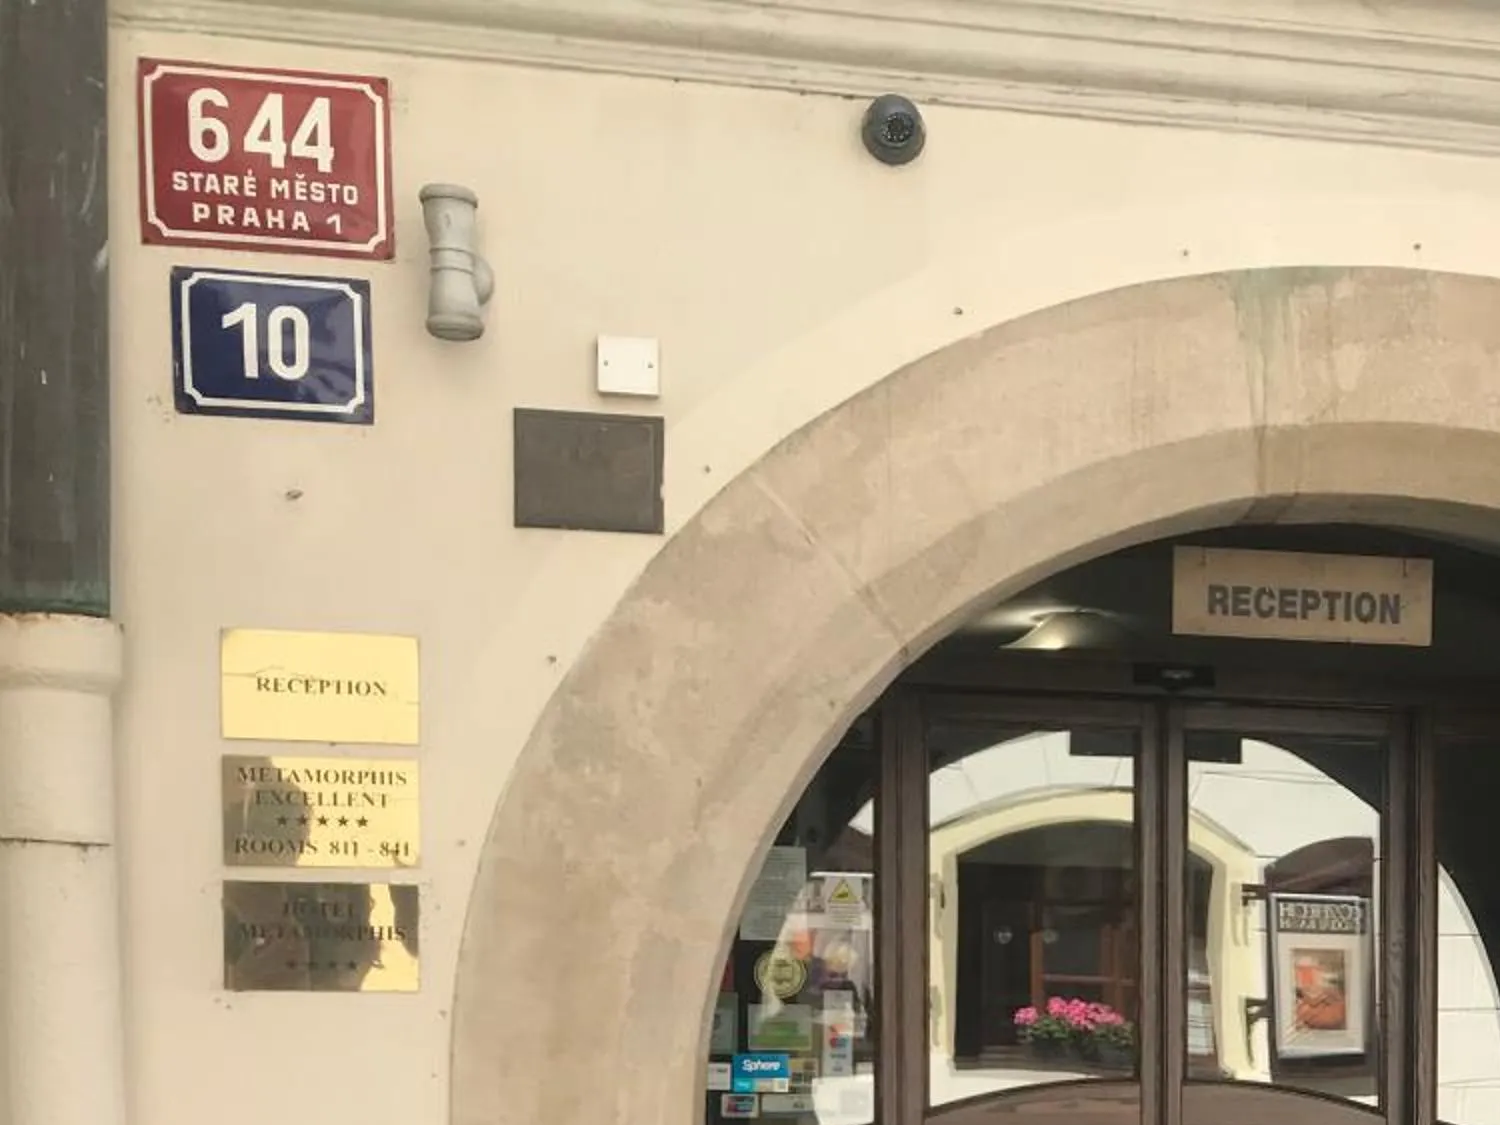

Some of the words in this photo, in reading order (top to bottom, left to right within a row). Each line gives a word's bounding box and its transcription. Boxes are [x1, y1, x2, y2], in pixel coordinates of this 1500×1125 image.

[187, 88, 334, 173] 644
[172, 169, 257, 198] STARÉ
[271, 174, 358, 205] MĚSTO
[193, 202, 309, 233] PRAHA
[326, 213, 343, 234] 1
[221, 302, 309, 380] 10
[1207, 584, 1401, 624] RECEPTION
[256, 677, 387, 697] RECEPTION
[237, 767, 407, 787] METAMORPHIS
[255, 790, 390, 809] EXCELLENT
[235, 838, 318, 857] ROOMS
[380, 840, 410, 858] 841
[283, 901, 354, 917] HTEL
[742, 1059, 780, 1072] Sphere
